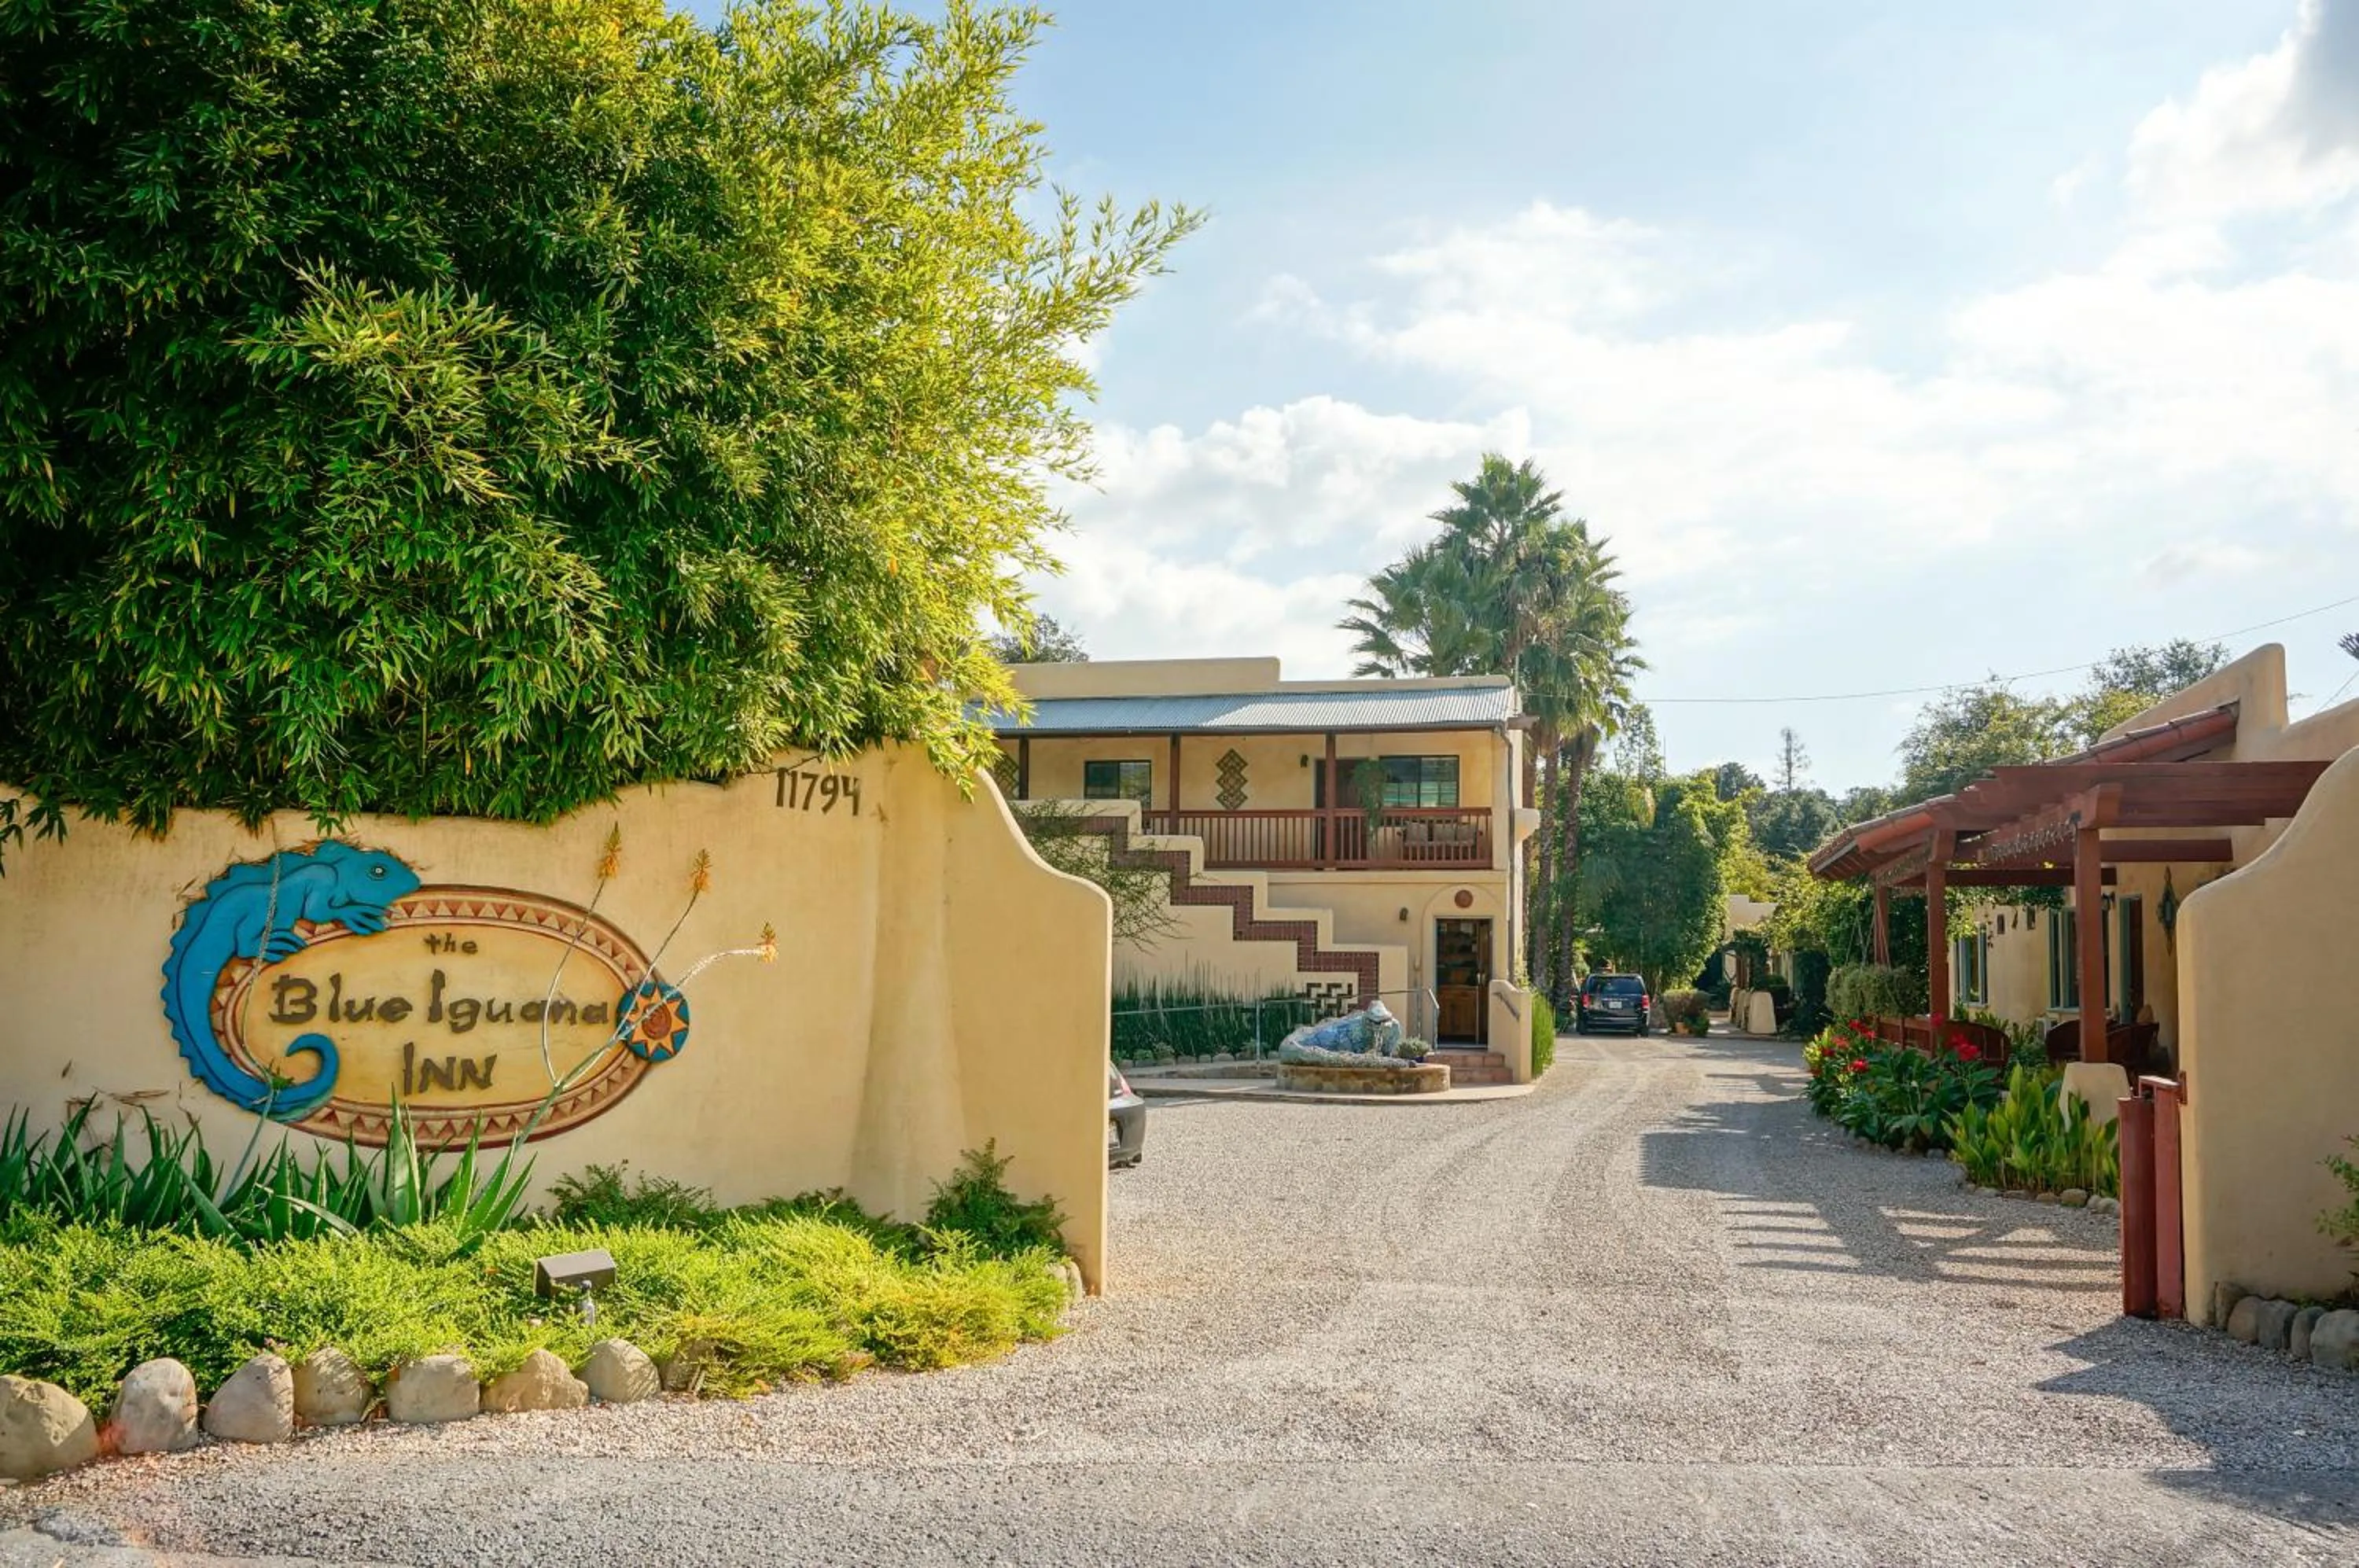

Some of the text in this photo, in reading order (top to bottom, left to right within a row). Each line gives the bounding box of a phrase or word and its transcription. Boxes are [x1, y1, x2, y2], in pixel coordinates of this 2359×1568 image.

[776, 767, 861, 815] 11794
[424, 933, 478, 955] the
[268, 969, 609, 1033] Blue Iguana
[403, 1042, 497, 1096] INN
